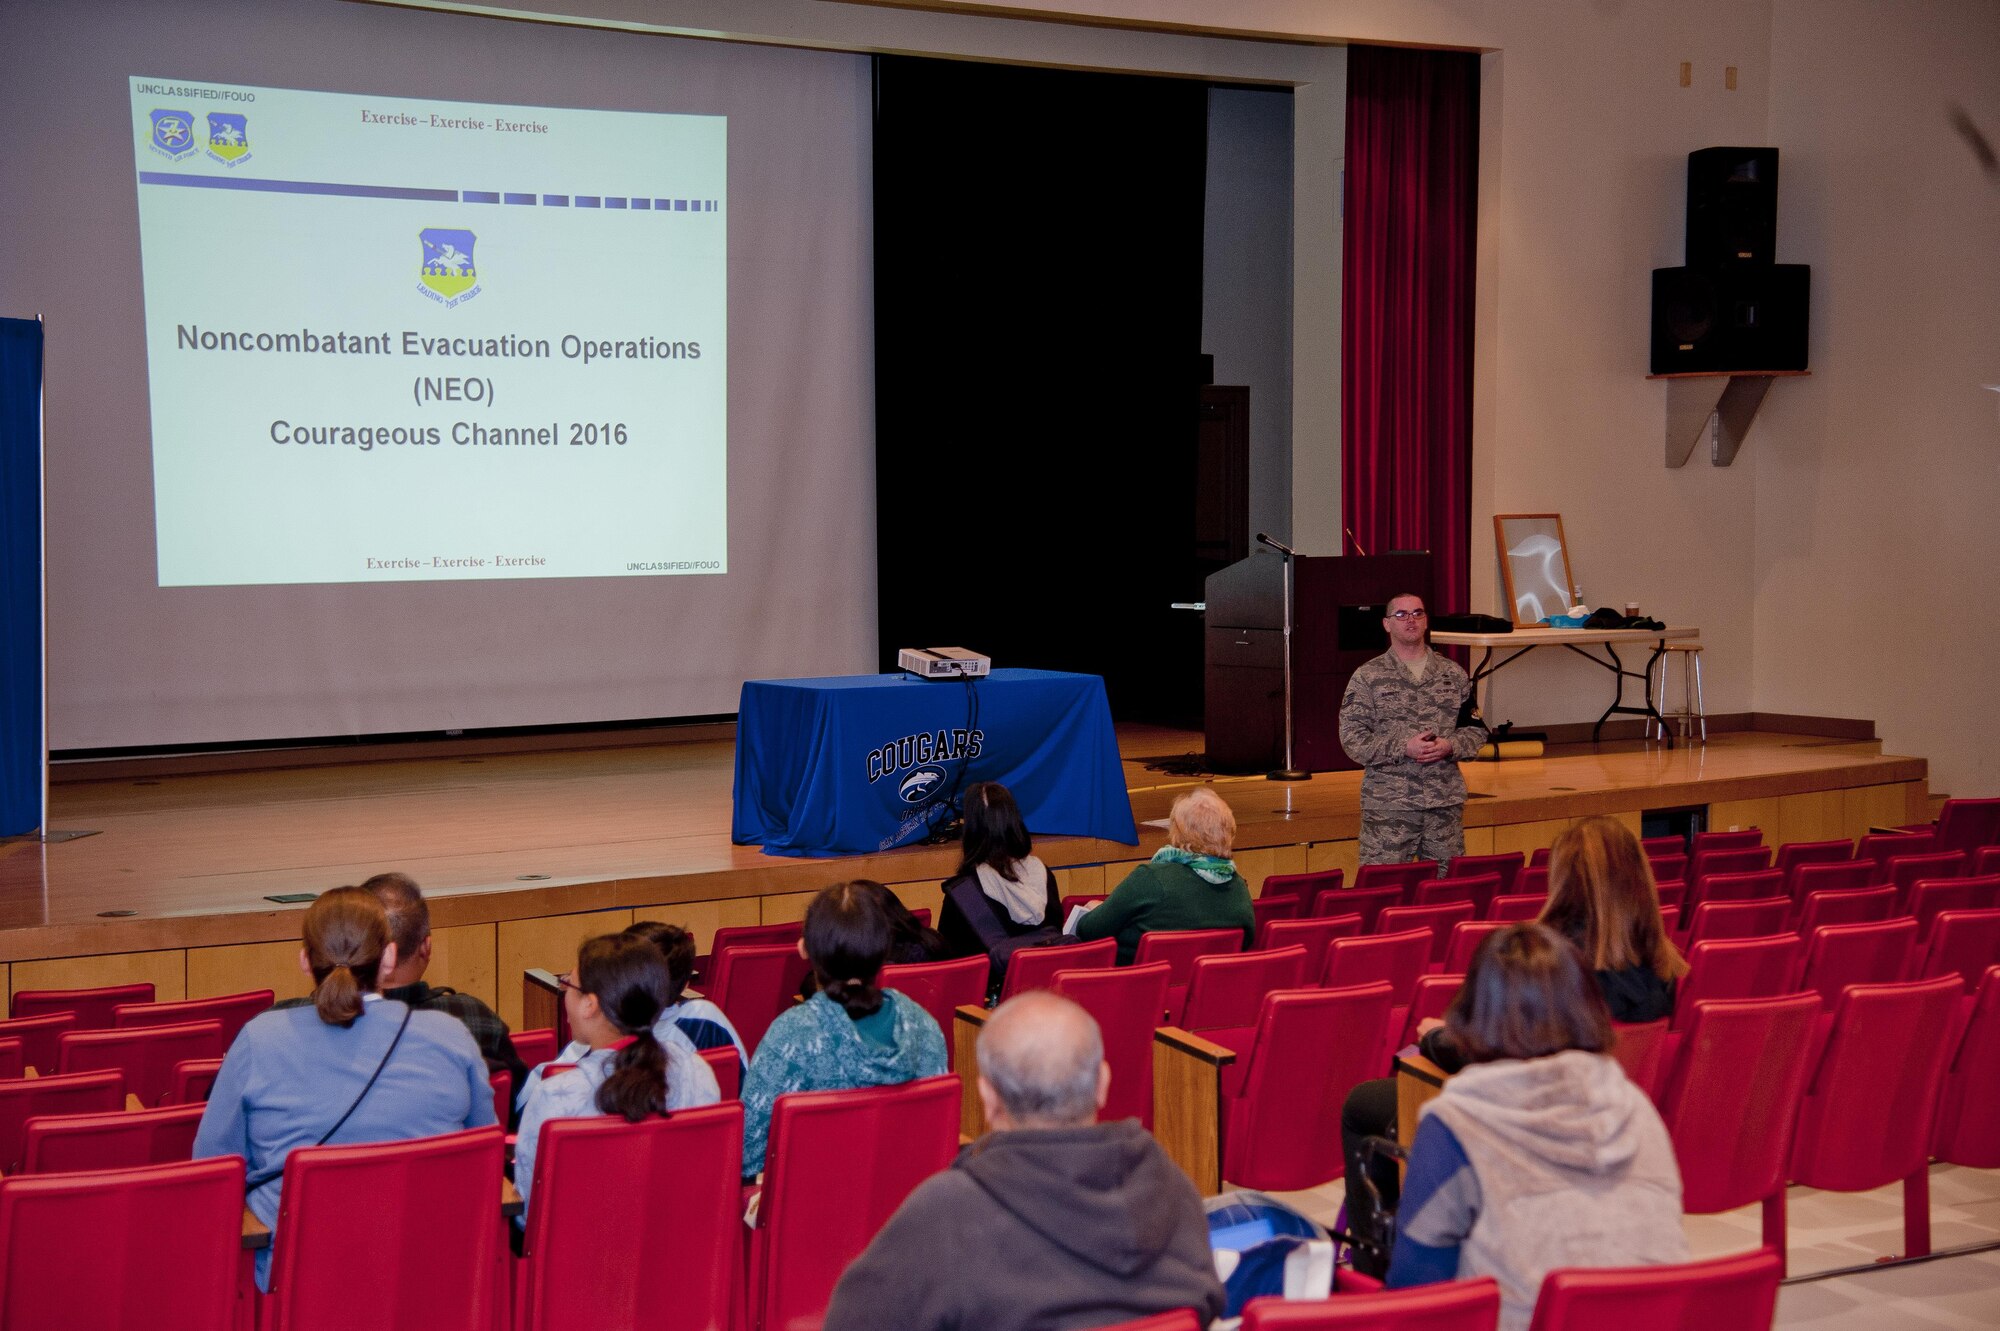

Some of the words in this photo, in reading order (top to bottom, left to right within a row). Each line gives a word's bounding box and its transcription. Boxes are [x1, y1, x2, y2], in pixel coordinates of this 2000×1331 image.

[137, 84, 255, 102] UNCLASSIFIED//FOUO
[361, 110, 417, 125] Exercise
[430, 114, 485, 131] Exercise
[495, 118, 549, 134] Exercise
[176, 324, 392, 355] Noncombatant
[402, 331, 551, 358] Evacuation
[560, 334, 701, 364] Operations
[413, 376, 494, 407] (NEO)
[270, 420, 441, 451] Courageous
[451, 421, 559, 446] Channel
[569, 422, 628, 446] 2016
[366, 556, 421, 570] Exercise
[432, 555, 485, 569] Exercise
[495, 554, 547, 567] Exercise
[626, 560, 720, 571] UNCLASSIFIED//FOUO
[866, 729, 984, 784] COUGARS
